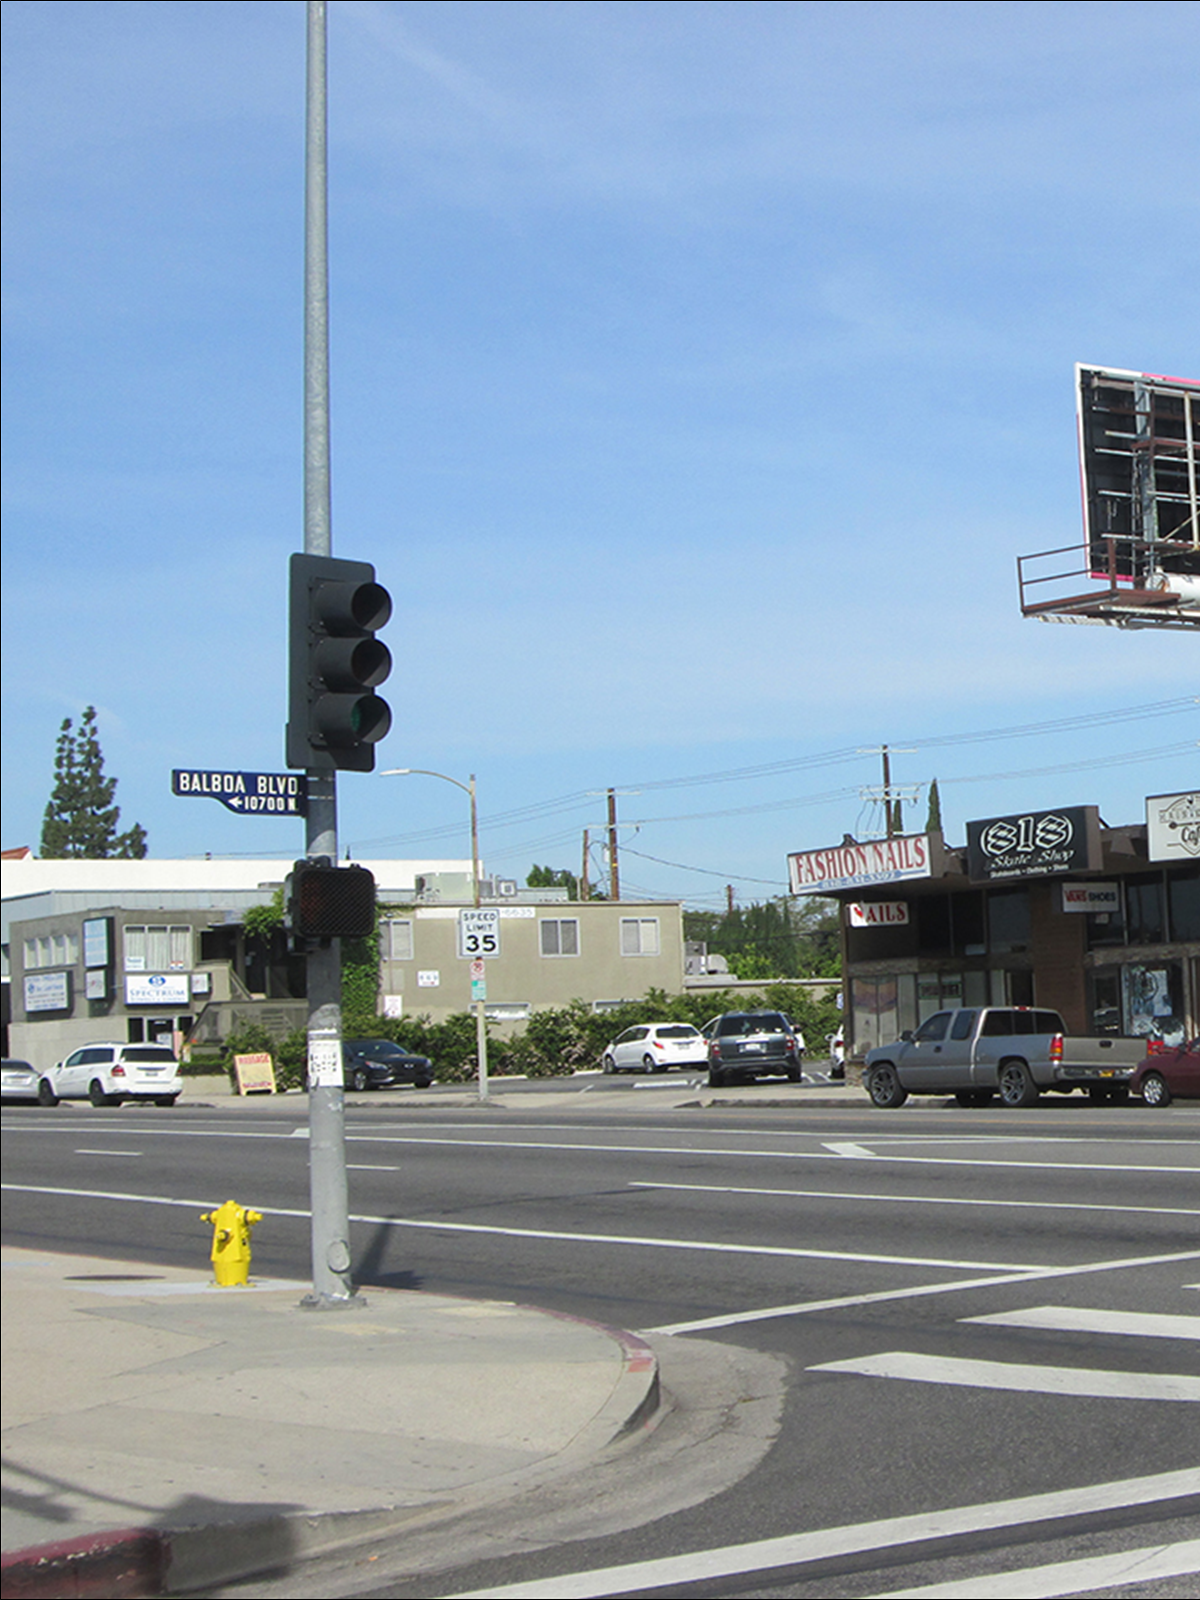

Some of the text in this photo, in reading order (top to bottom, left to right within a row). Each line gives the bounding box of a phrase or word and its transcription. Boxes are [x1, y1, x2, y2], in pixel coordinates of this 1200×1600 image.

[179, 772, 246, 794] BALBOA
[244, 796, 284, 811] 10700
[796, 837, 926, 884] FASHION NAILS
[990, 849, 1075, 868] Skate Shop
[463, 912, 497, 921] SPEED
[466, 923, 493, 932] LIMIT
[466, 934, 496, 952] 35
[130, 988, 185, 997] SPECTRUM
